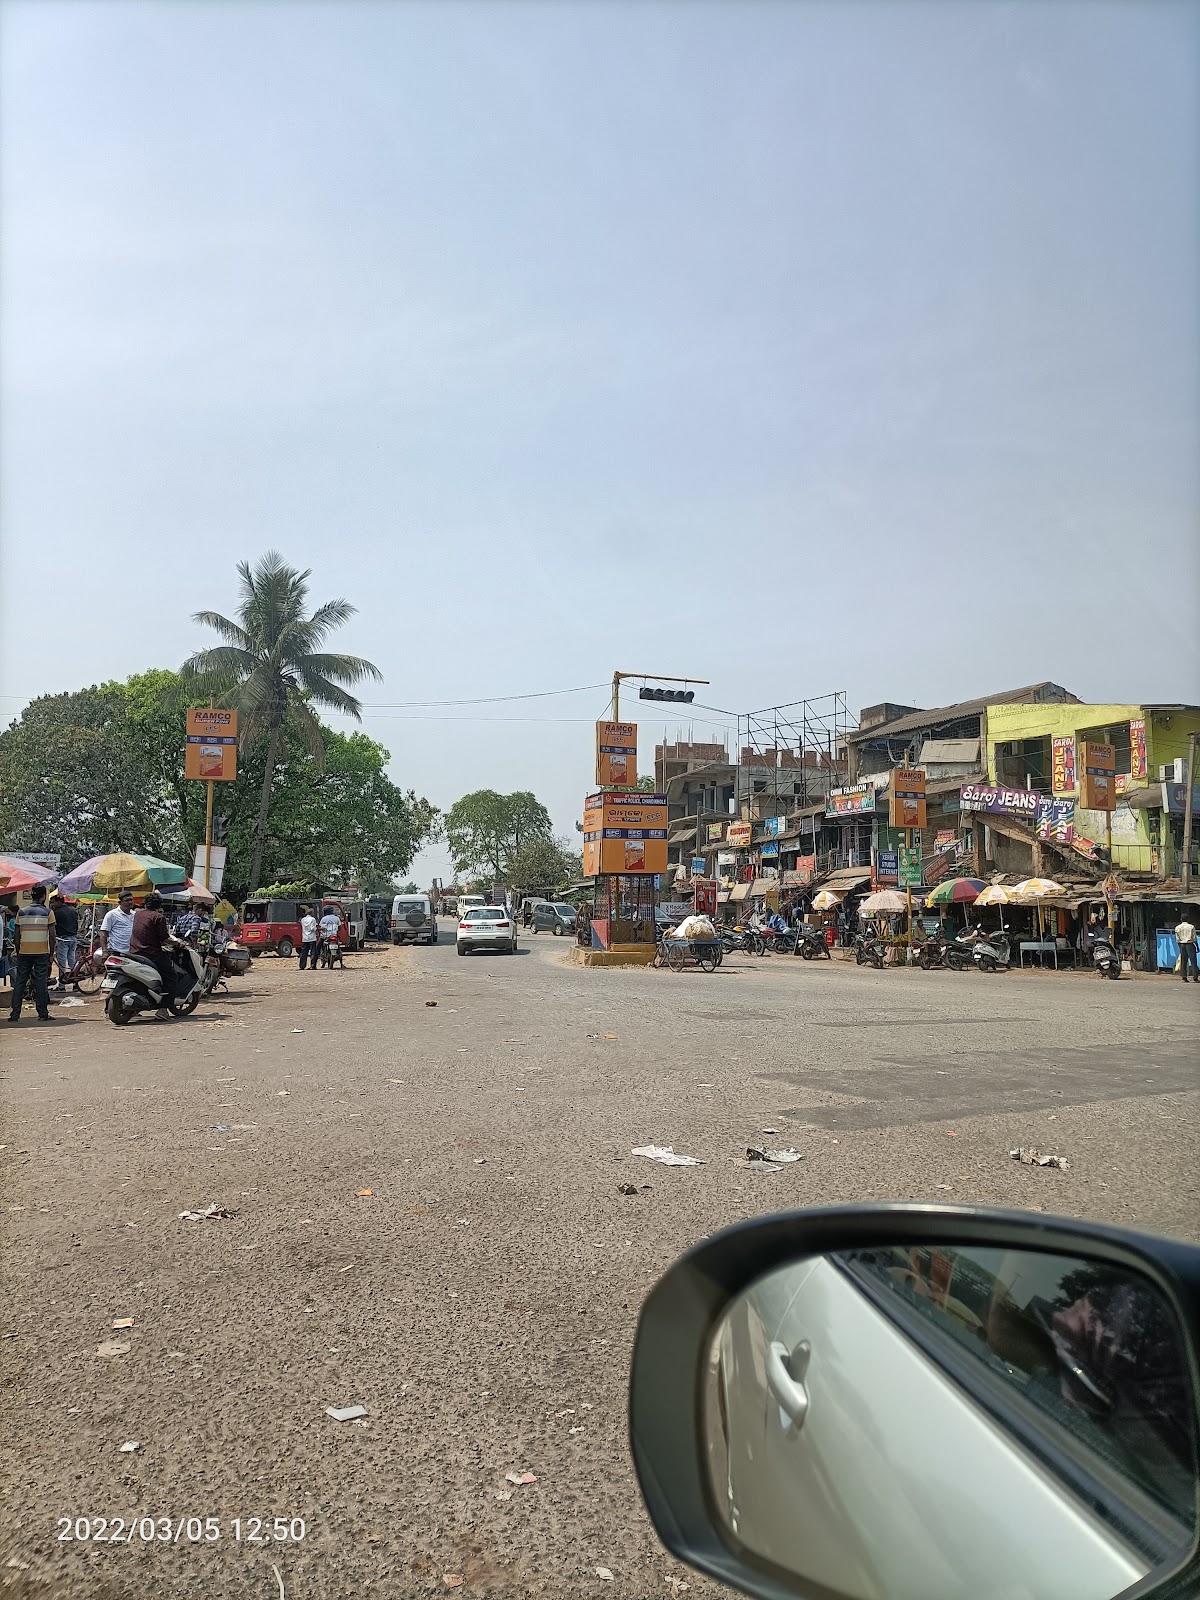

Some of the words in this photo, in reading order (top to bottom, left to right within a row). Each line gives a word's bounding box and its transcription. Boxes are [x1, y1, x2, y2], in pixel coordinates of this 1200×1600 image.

[195, 712, 231, 720] RAMCO
[605, 724, 633, 732] RAMCO
[1130, 720, 1145, 730] SAROJ
[1054, 738, 1074, 748] SAROJ
[1089, 745, 1112, 753] RAMCO
[1131, 730, 1139, 776] JEANS
[1055, 747, 1065, 791] JEANS
[843, 784, 867, 795] FASHION
[963, 786, 998, 806] Saroj
[998, 791, 1037, 810] JEANS
[1039, 795, 1053, 808] Saroj
[1054, 797, 1074, 810] Saroj
[1040, 804, 1049, 837] JEANS
[1056, 807, 1068, 840] JEANS
